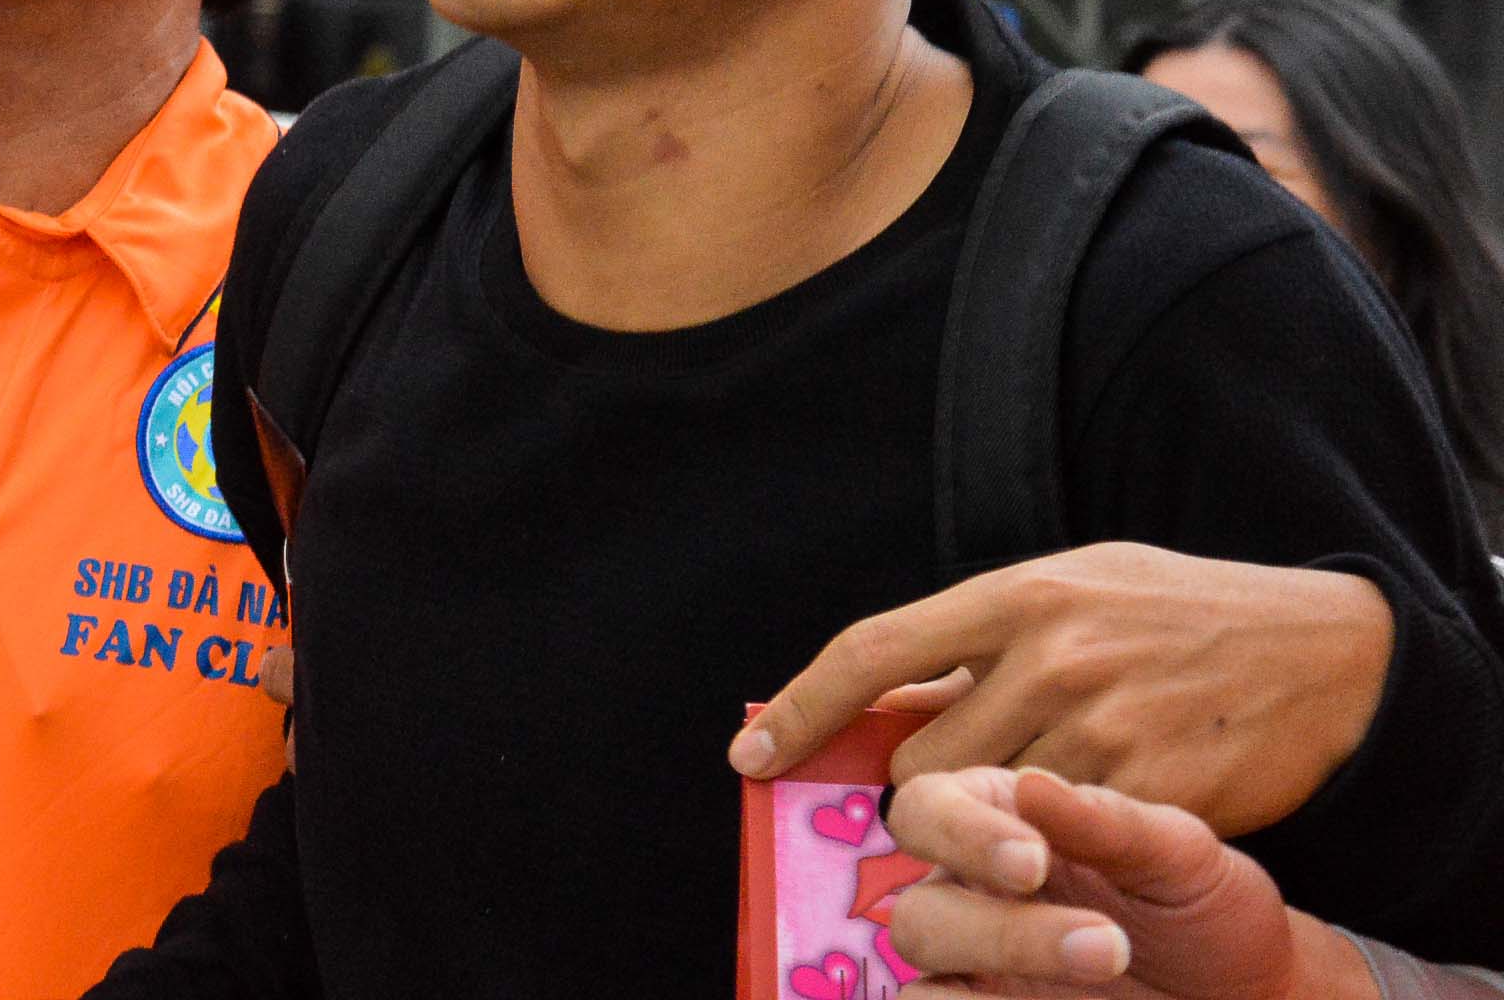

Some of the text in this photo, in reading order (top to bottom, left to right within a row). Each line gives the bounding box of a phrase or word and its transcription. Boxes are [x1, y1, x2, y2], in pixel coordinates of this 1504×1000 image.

[166, 482, 202, 516] SHB
[73, 558, 153, 604] SHB
[167, 564, 219, 616] ĐÀ
[59, 612, 273, 688] FAN CL
